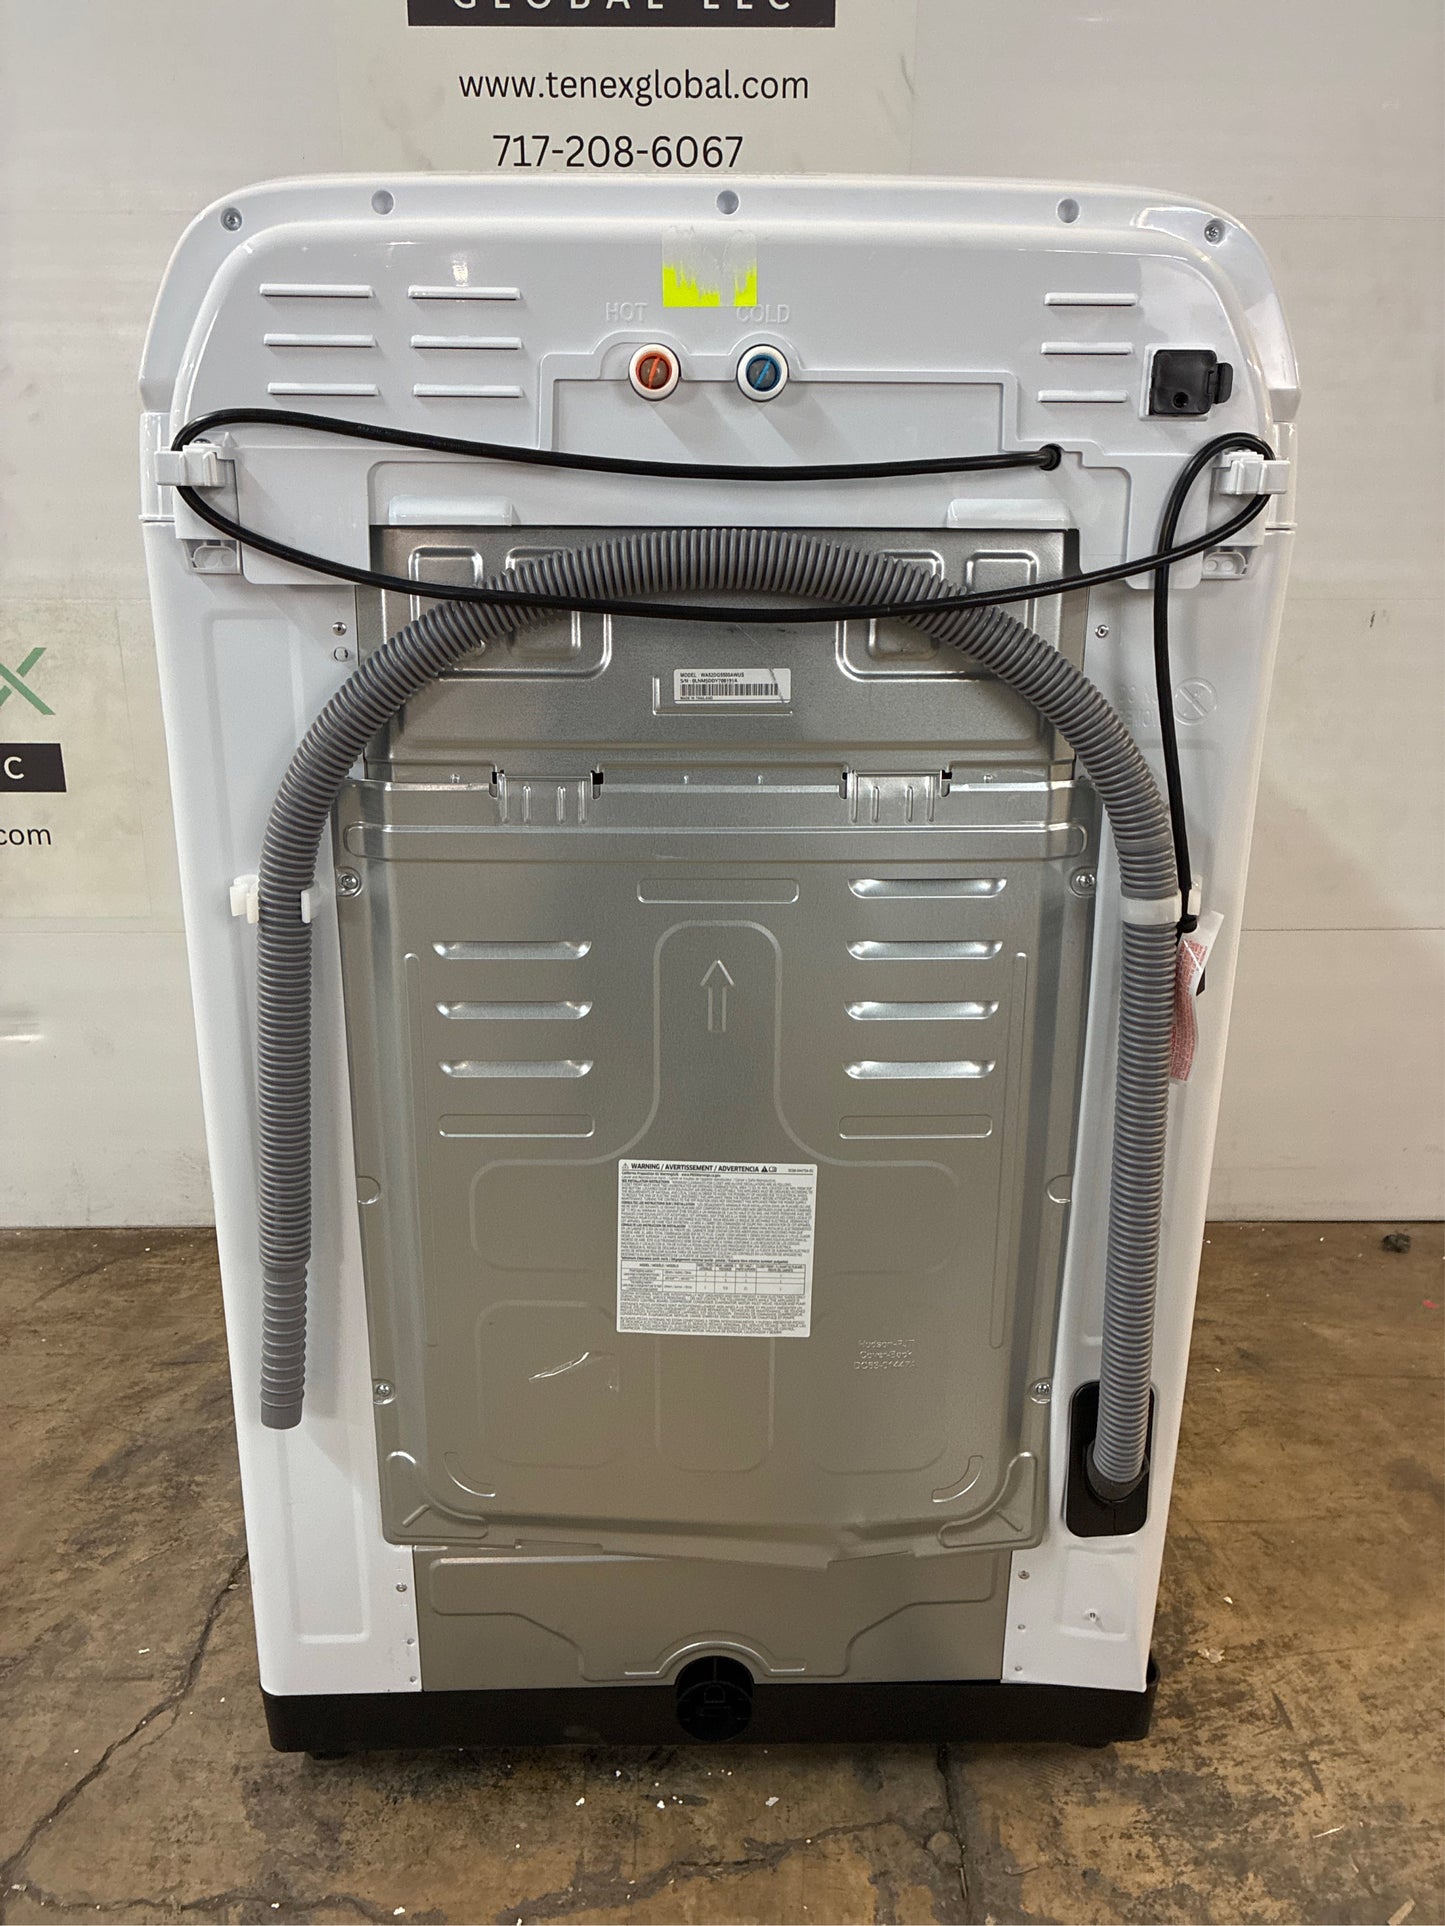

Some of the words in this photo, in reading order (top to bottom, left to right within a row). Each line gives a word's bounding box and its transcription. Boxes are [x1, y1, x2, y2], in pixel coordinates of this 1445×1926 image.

[459, 69, 809, 107] www.tenexglobal.com
[493, 134, 744, 168] 717-208-6067
[605, 302, 648, 322] HOT
[736, 304, 790, 323] COLD
